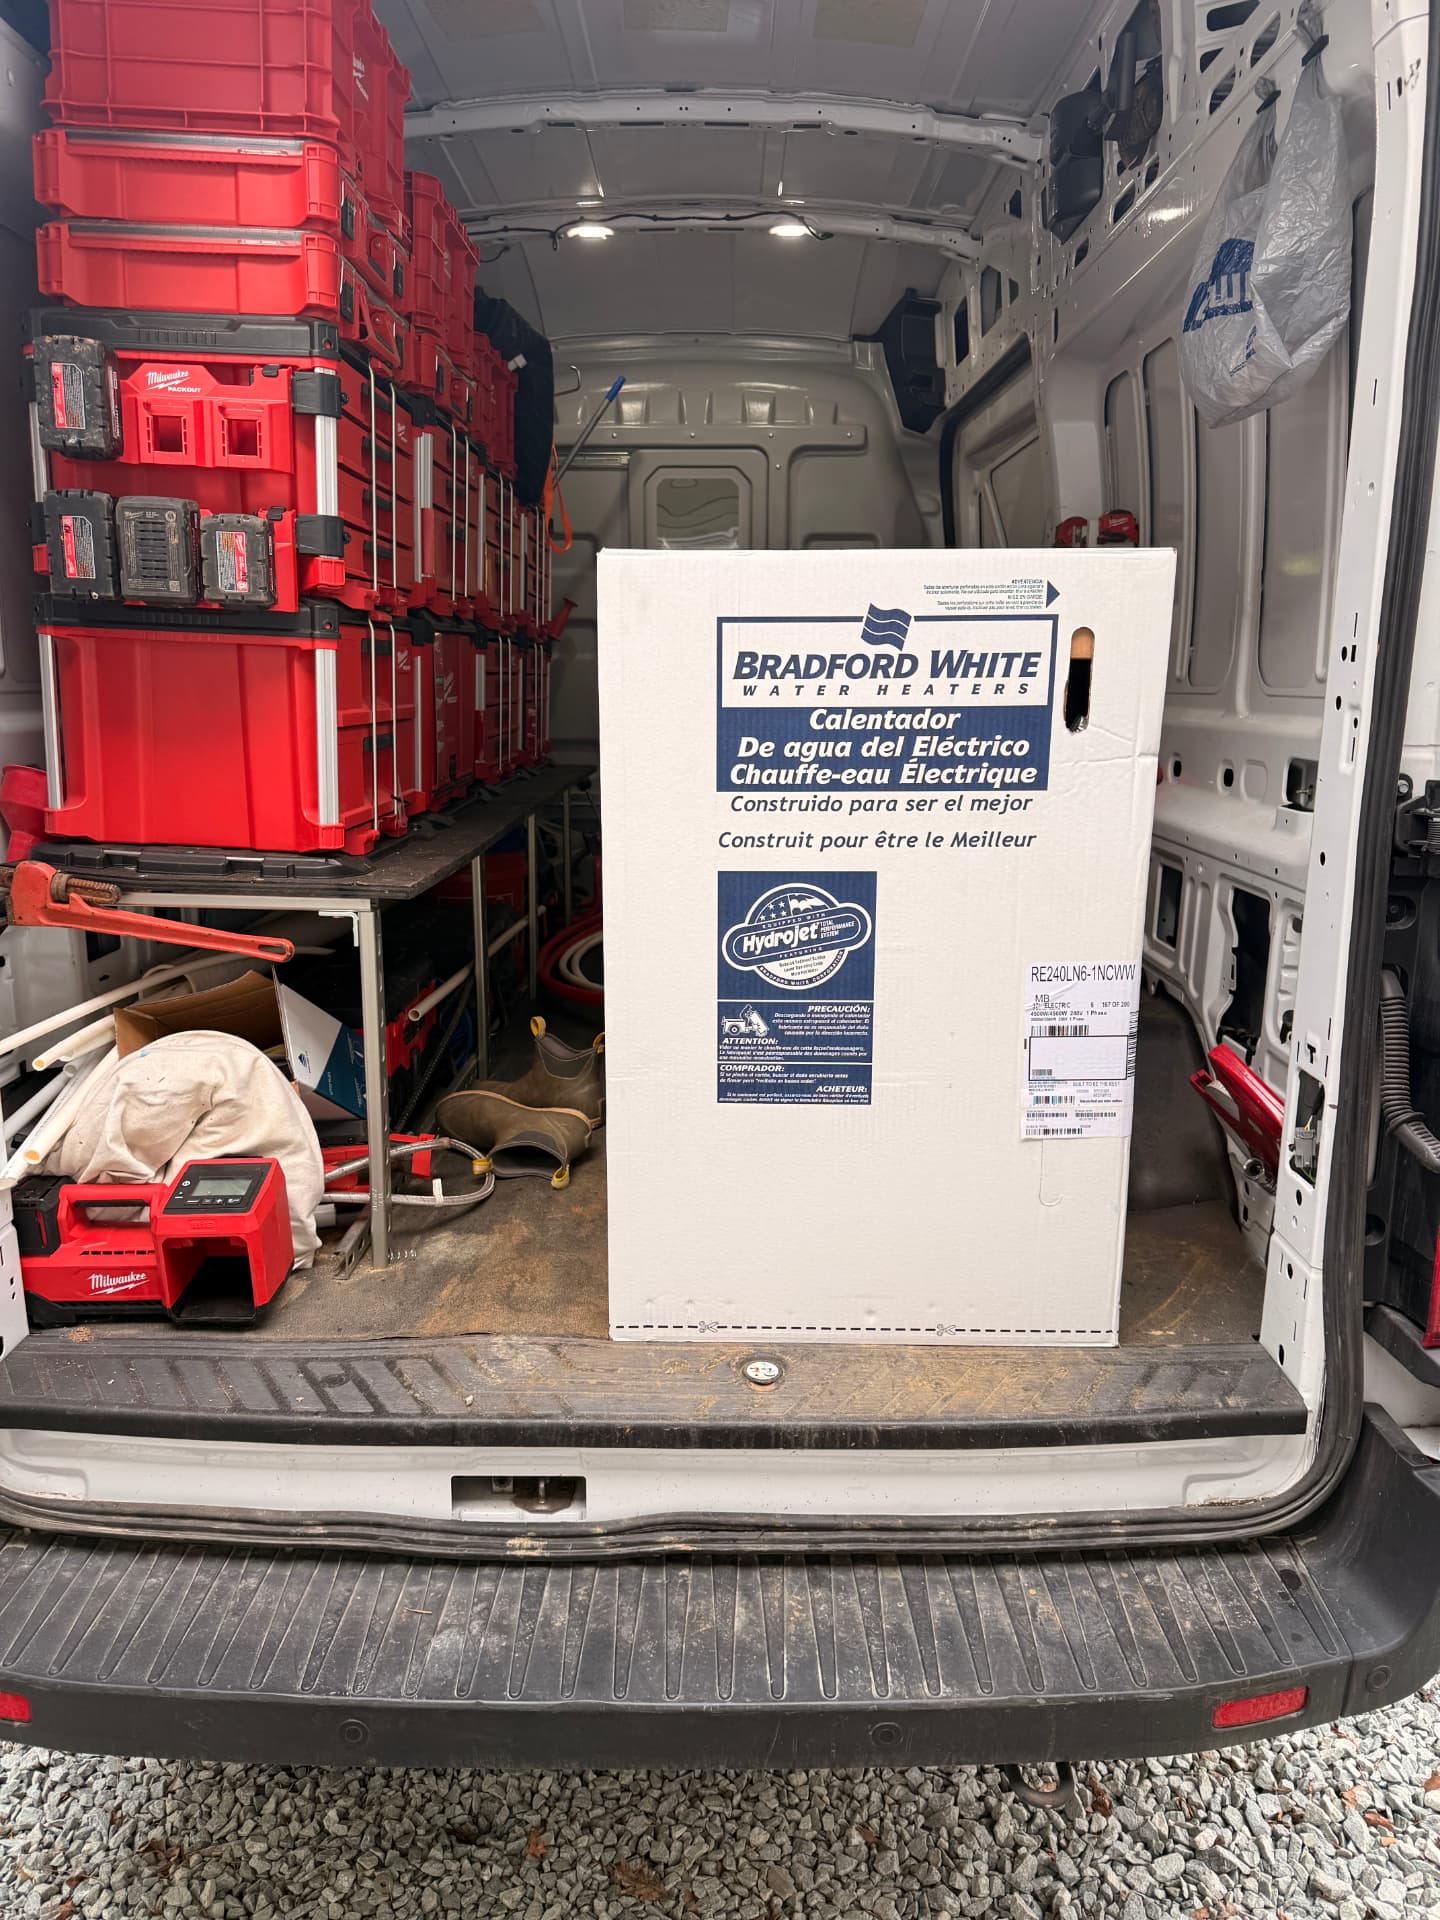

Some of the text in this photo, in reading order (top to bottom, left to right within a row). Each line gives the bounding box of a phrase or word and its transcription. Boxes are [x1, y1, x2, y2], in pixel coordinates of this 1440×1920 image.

[733, 649, 1042, 680] BRADFORD WHITE
[743, 683, 1029, 696] WATER HEATERS
[809, 708, 962, 730] Calentador
[737, 734, 1030, 762] De agua del Eléctrico
[730, 757, 1038, 789] Chauffe-eau Électrique
[731, 793, 1033, 816] Construido para ser el mejor
[718, 830, 1037, 852] Construit pour être le Meilleur
[742, 922, 818, 955] Hydrojet
[1031, 964, 1136, 982] RE240LN6-1NCWW
[807, 1004, 871, 1013] PRECAUCIÓN:
[1035, 994, 1050, 1002] MB
[87, 1272, 148, 1290] Milwaukee
